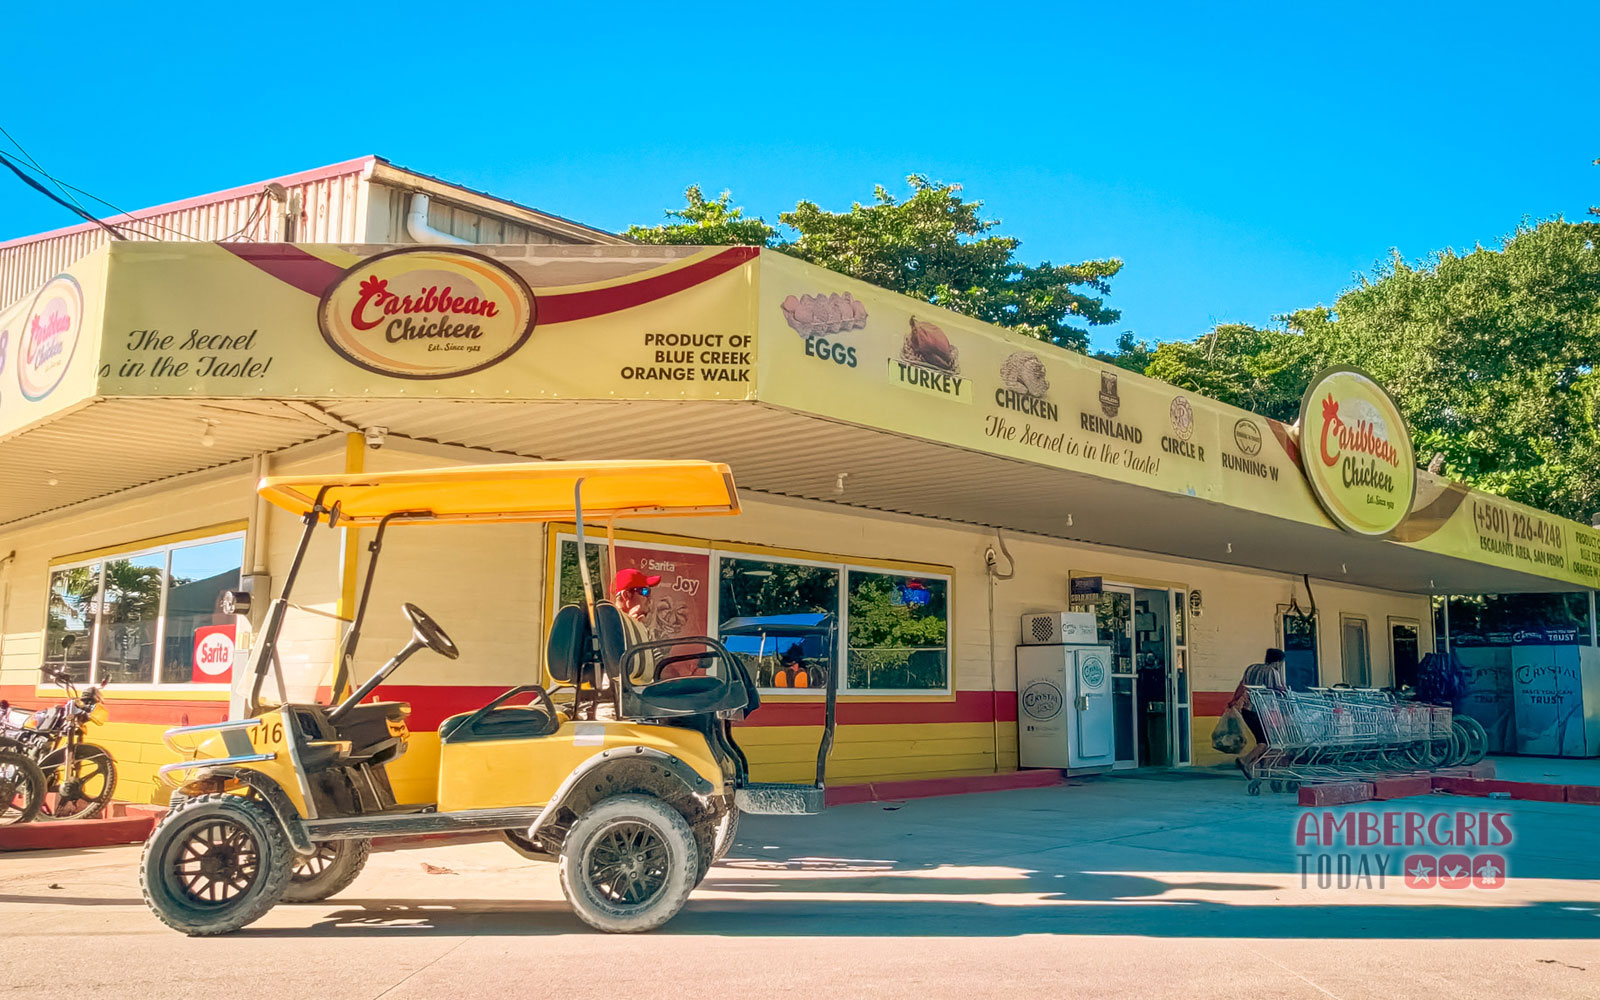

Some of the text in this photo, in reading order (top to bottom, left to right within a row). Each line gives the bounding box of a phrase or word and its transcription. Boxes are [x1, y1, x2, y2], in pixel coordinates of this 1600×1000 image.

[351, 275, 499, 331] Caribbean
[127, 329, 258, 350] The Secret
[385, 315, 483, 343] Chicken
[644, 334, 752, 348] PRODUCT OF
[655, 351, 750, 365] BLUE CREEK
[805, 336, 857, 368] EGGS
[119, 359, 146, 377] in
[150, 356, 189, 377] the
[196, 356, 273, 378] Taste!
[620, 367, 750, 382] ORANGE WALK
[898, 363, 962, 396] TURKEY
[995, 388, 1058, 422] CHICKEN
[1080, 412, 1142, 444] REINLAND
[1320, 392, 1399, 468] Caribbean
[985, 415, 1160, 476] The Secret is in the Taste!
[1161, 436, 1205, 464] CIRCLE R
[1222, 452, 1279, 482] RUNNING W
[1342, 456, 1394, 493] Chicken
[1473, 501, 1562, 549] (+501) 226-4248
[648, 559, 675, 572] Sarita
[1480, 536, 1514, 557] ESCALANTE
[1533, 549, 1545, 564] SAN
[1546, 553, 1564, 568] PEDRO
[672, 576, 700, 596] Joy
[201, 642, 229, 663] Sarita
[1531, 696, 1564, 704] TRUST
[250, 722, 283, 746] 116
